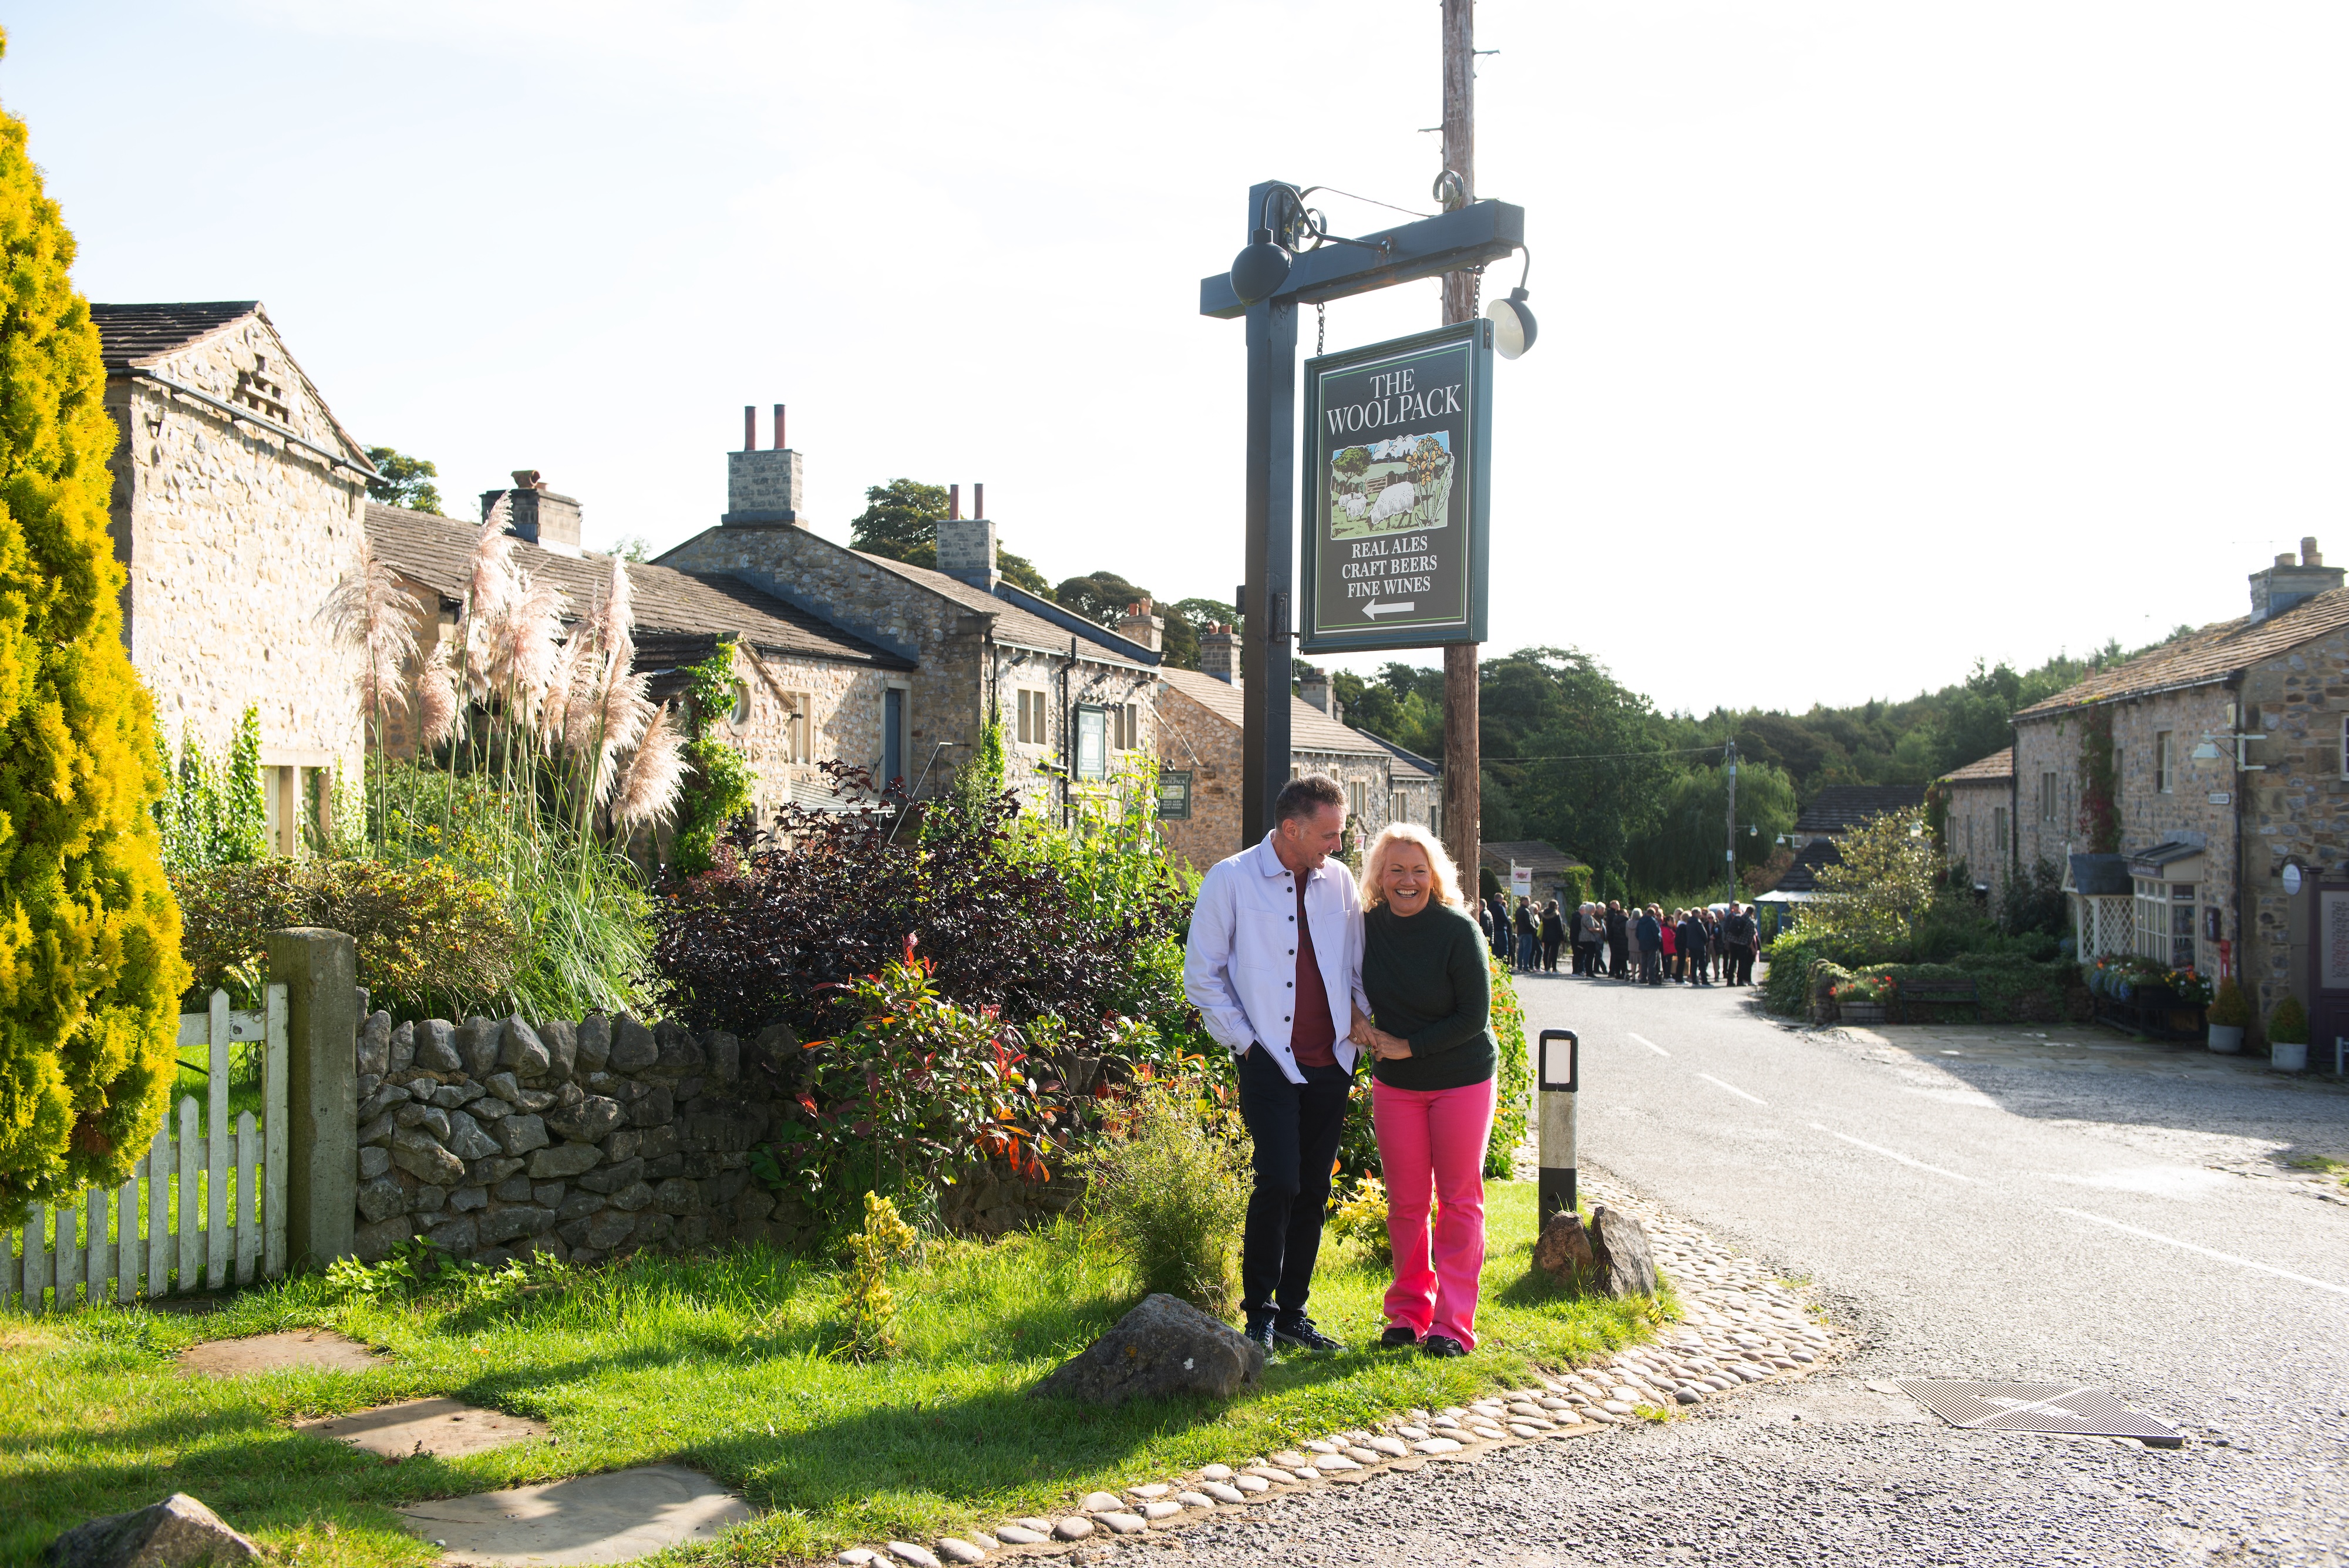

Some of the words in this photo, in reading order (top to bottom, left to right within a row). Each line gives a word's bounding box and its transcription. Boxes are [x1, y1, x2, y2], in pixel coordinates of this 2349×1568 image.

[1370, 368, 1415, 399] THE
[1327, 384, 1462, 435] WOOLPACK
[1352, 540, 1388, 558] REAL
[1391, 536, 1428, 554] ALES
[1342, 560, 1387, 579] CRAFT
[1391, 555, 1437, 574] BEERS
[1348, 580, 1379, 598] FINE
[1384, 576, 1431, 595] WINES
